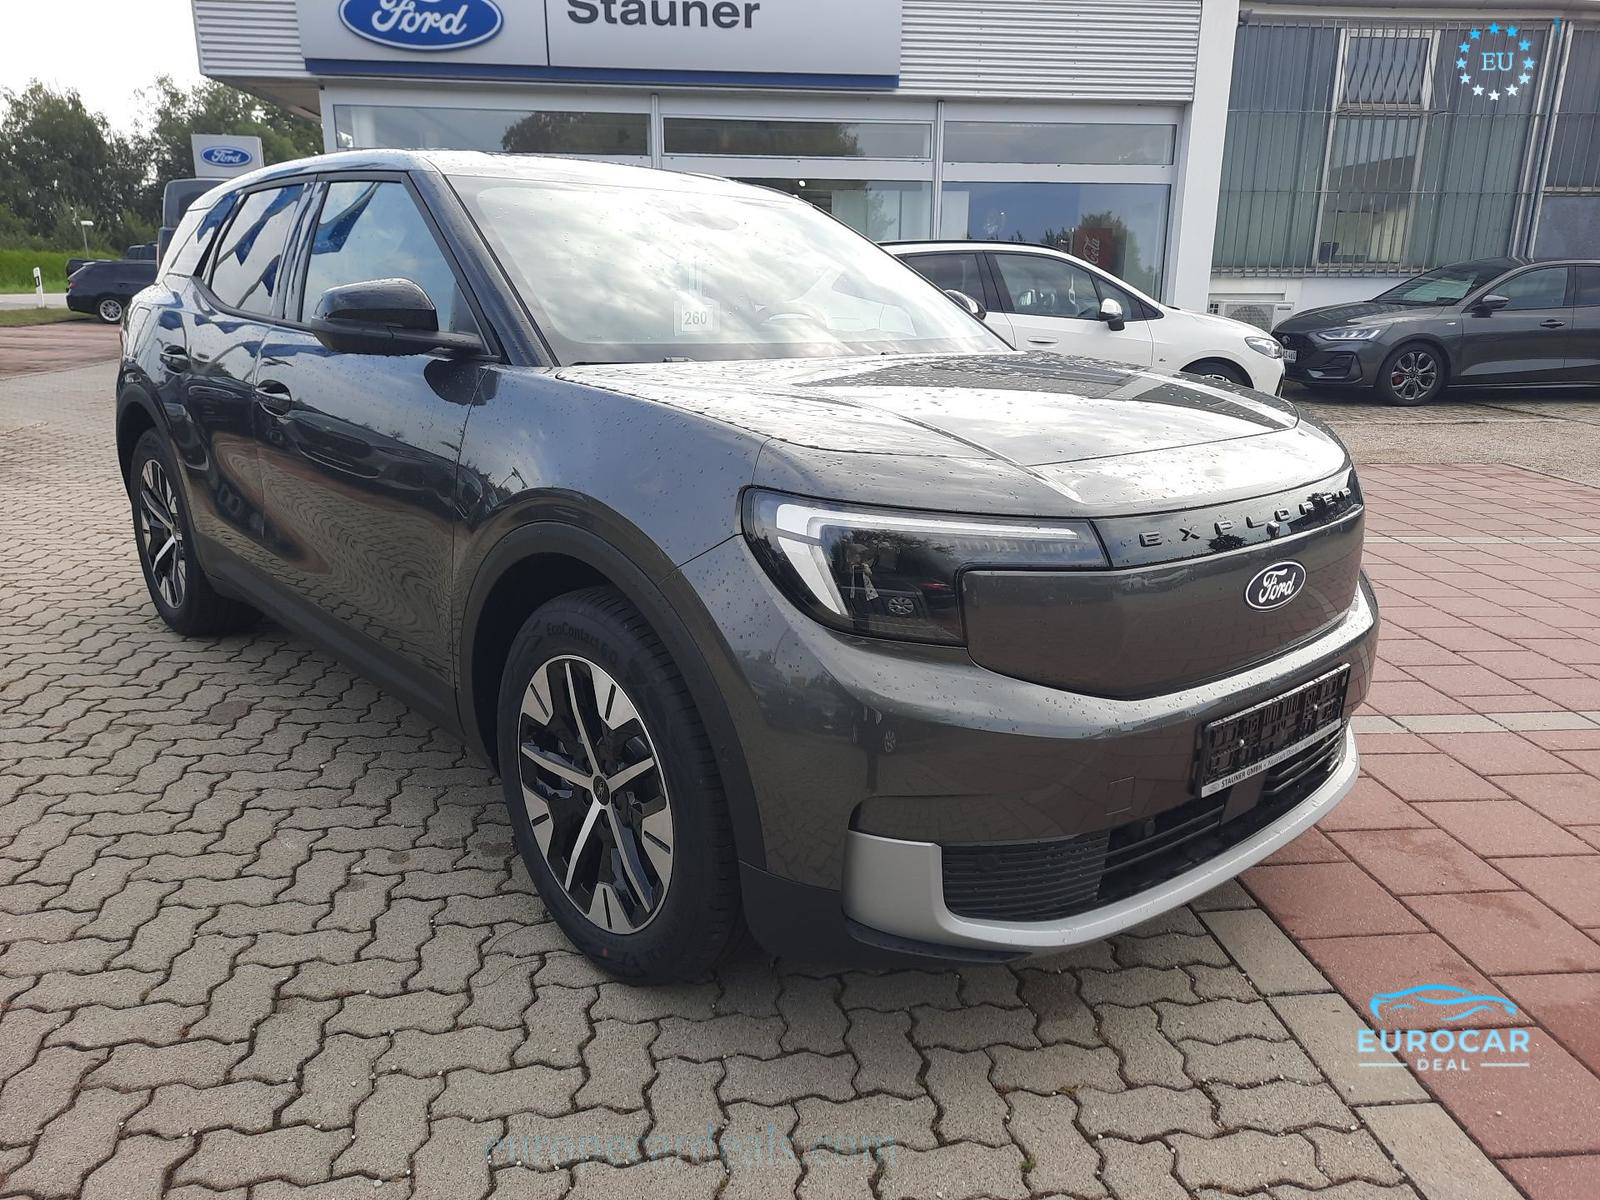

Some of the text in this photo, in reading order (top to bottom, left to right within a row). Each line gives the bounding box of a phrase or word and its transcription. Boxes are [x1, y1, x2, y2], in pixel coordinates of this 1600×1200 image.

[371, 0, 470, 35] Ford
[567, 0, 761, 29] Stauner
[211, 149, 242, 163] Ford
[684, 311, 707, 325] 260
[1138, 487, 1352, 548] EXPLORER
[1258, 567, 1295, 604] Ford
